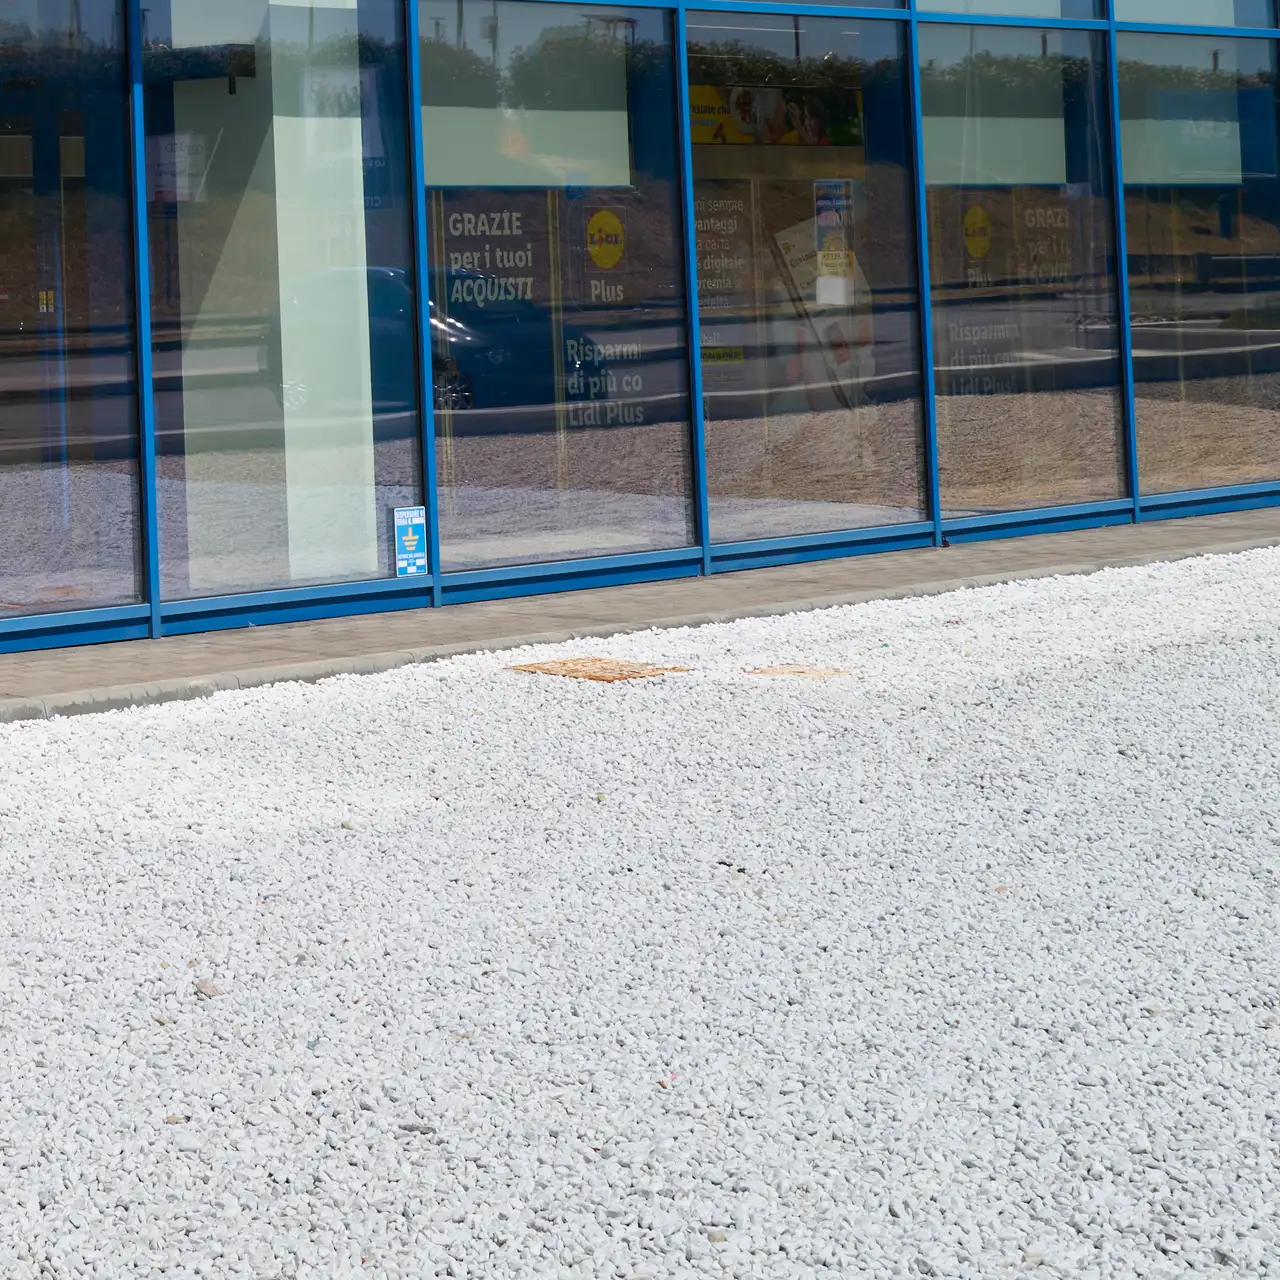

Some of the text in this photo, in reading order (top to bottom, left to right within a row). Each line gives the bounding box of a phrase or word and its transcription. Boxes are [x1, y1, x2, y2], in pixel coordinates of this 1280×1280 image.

[448, 211, 522, 237] GRAZIE
[450, 243, 533, 275] per i tuoi
[450, 277, 534, 307] ACQUISTI
[590, 279, 624, 302] Plus
[567, 371, 584, 394] di
[589, 369, 617, 398] più
[568, 401, 644, 426] Lidl Plus
